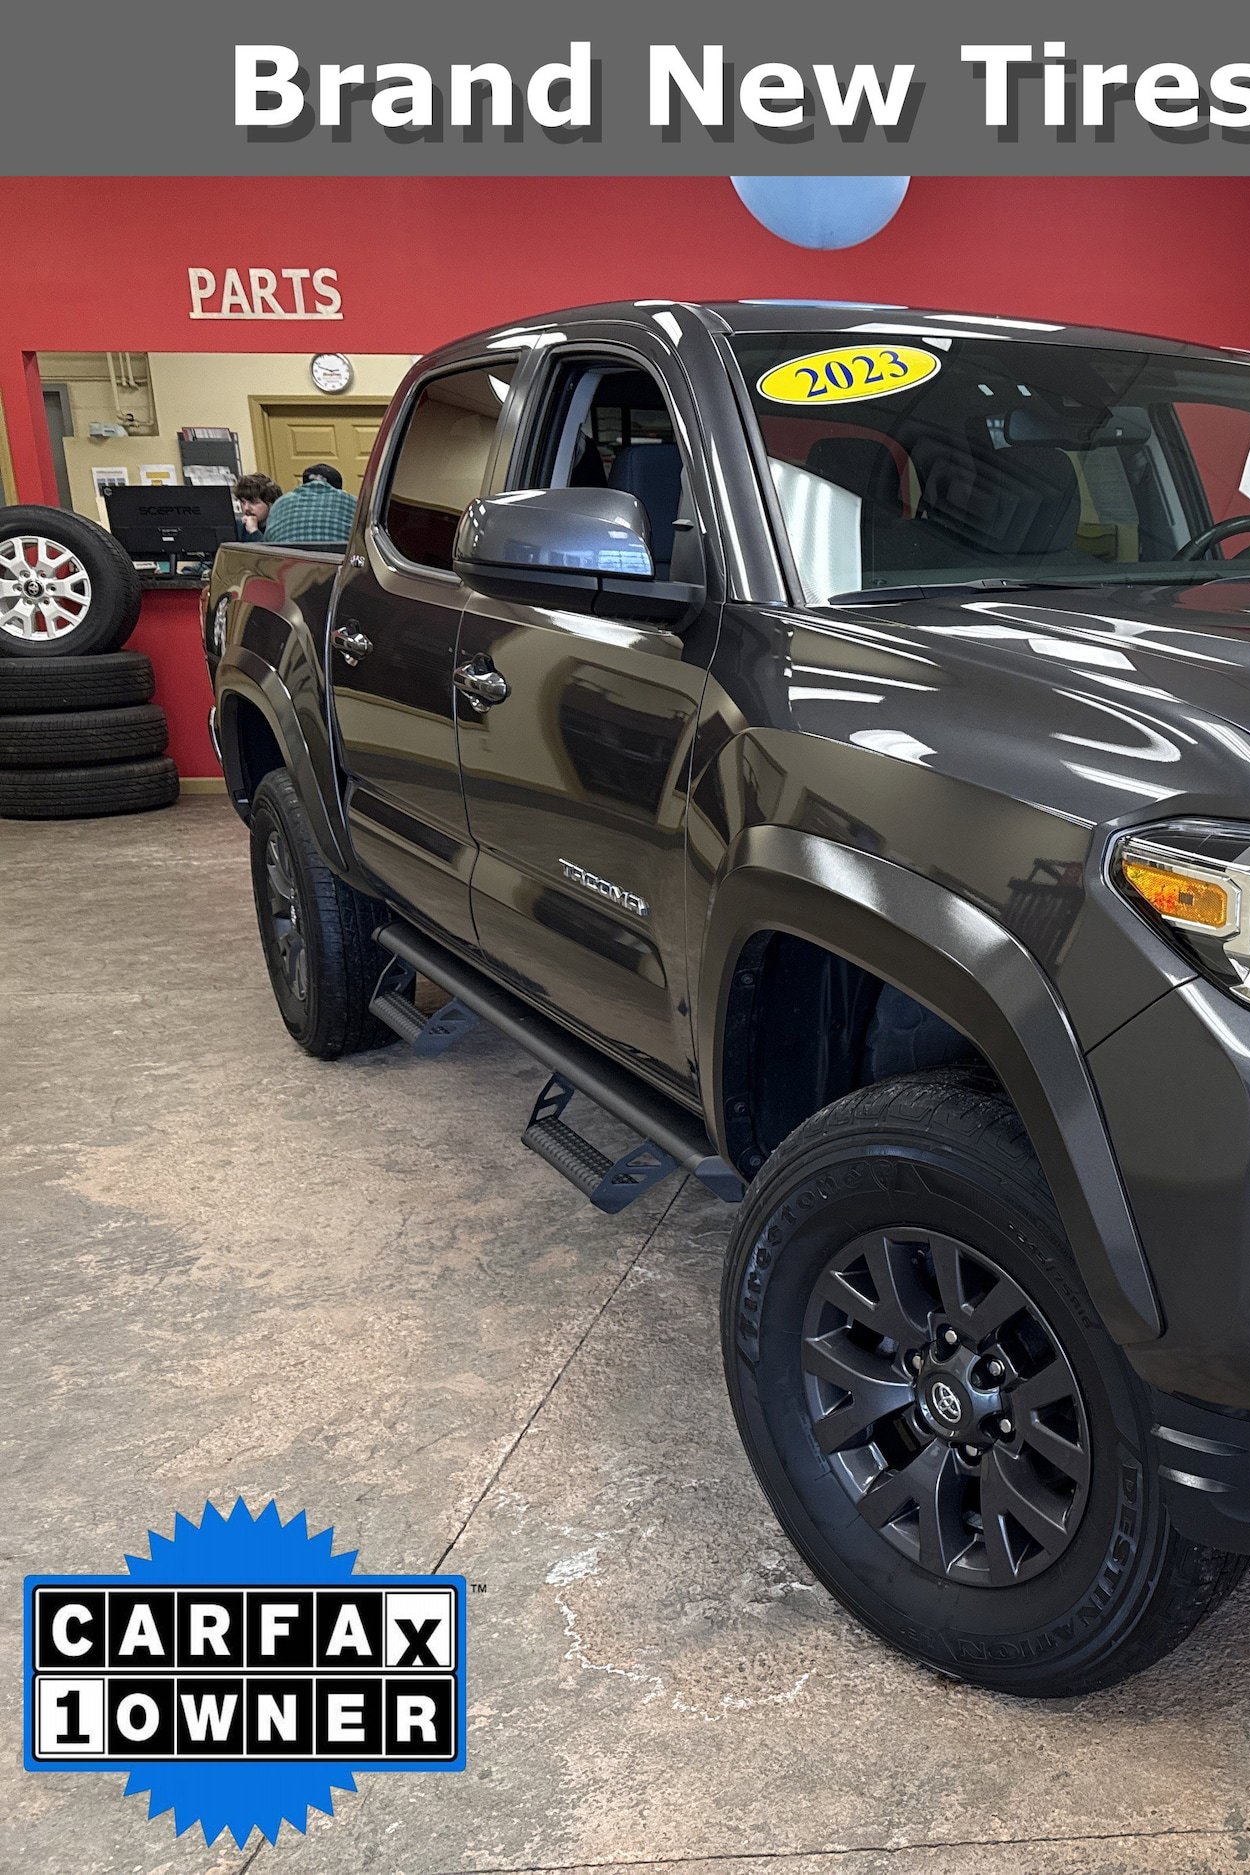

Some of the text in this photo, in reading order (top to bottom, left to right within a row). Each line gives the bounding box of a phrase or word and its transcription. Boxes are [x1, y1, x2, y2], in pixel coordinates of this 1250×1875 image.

[187, 267, 342, 316] PARTS
[794, 350, 909, 398] 2023
[138, 506, 201, 516] SCEPTRE
[558, 858, 650, 917] TACOMA
[958, 1463, 1139, 1661] DESTINATION
